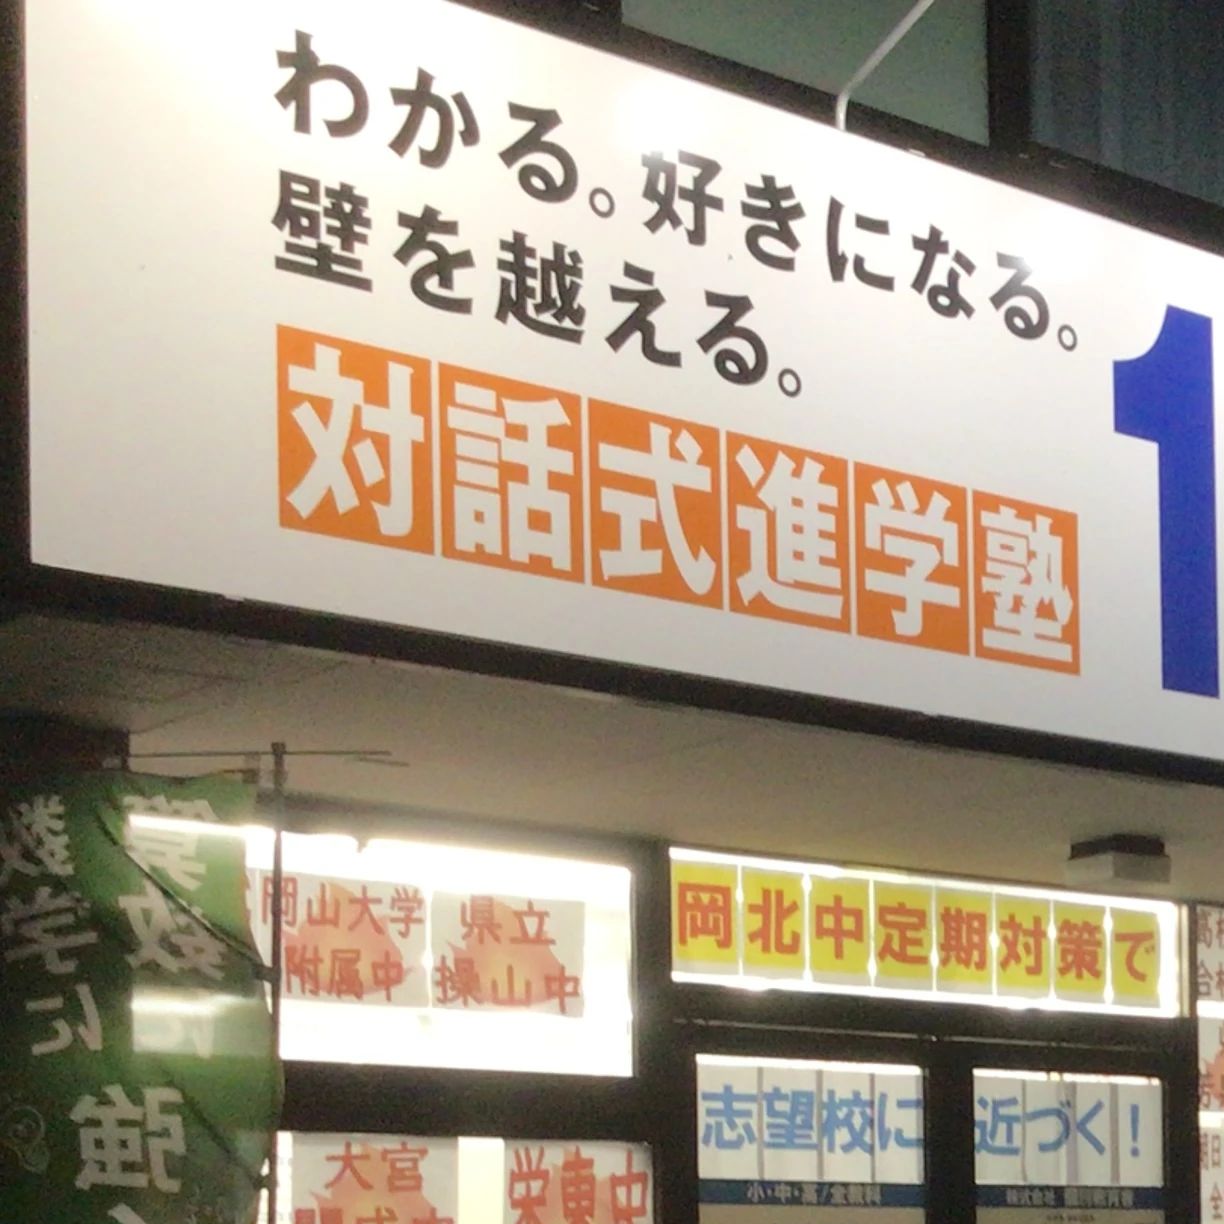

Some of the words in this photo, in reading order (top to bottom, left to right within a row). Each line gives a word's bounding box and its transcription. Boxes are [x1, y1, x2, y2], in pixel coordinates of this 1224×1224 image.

[275, 30, 1077, 352] わかる。好きになる。
[271, 170, 802, 398] 壁を越える。
[286, 345, 1074, 664] 対話式進学塾
[460, 895, 557, 946] 県立
[677, 880, 1156, 983] 岡北中定期対策で
[323, 1140, 429, 1193] 大宮
[701, 1083, 925, 1155] 志望校に
